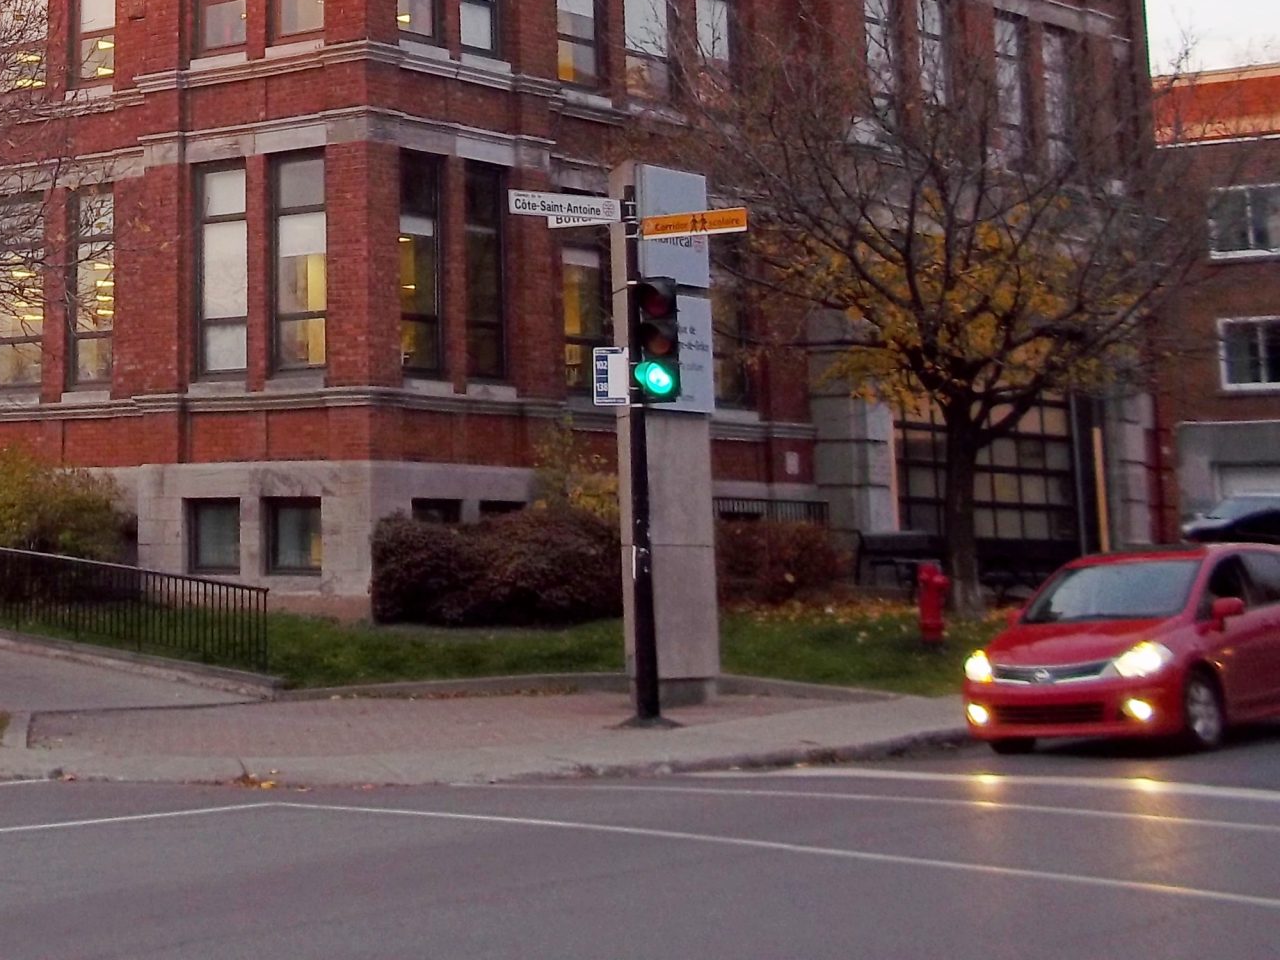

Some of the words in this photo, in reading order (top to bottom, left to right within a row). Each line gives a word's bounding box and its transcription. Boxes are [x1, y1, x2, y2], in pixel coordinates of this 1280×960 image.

[514, 198, 601, 216] Côte-Saint-Antoine
[596, 360, 608, 370] 102
[596, 382, 608, 392] 138
